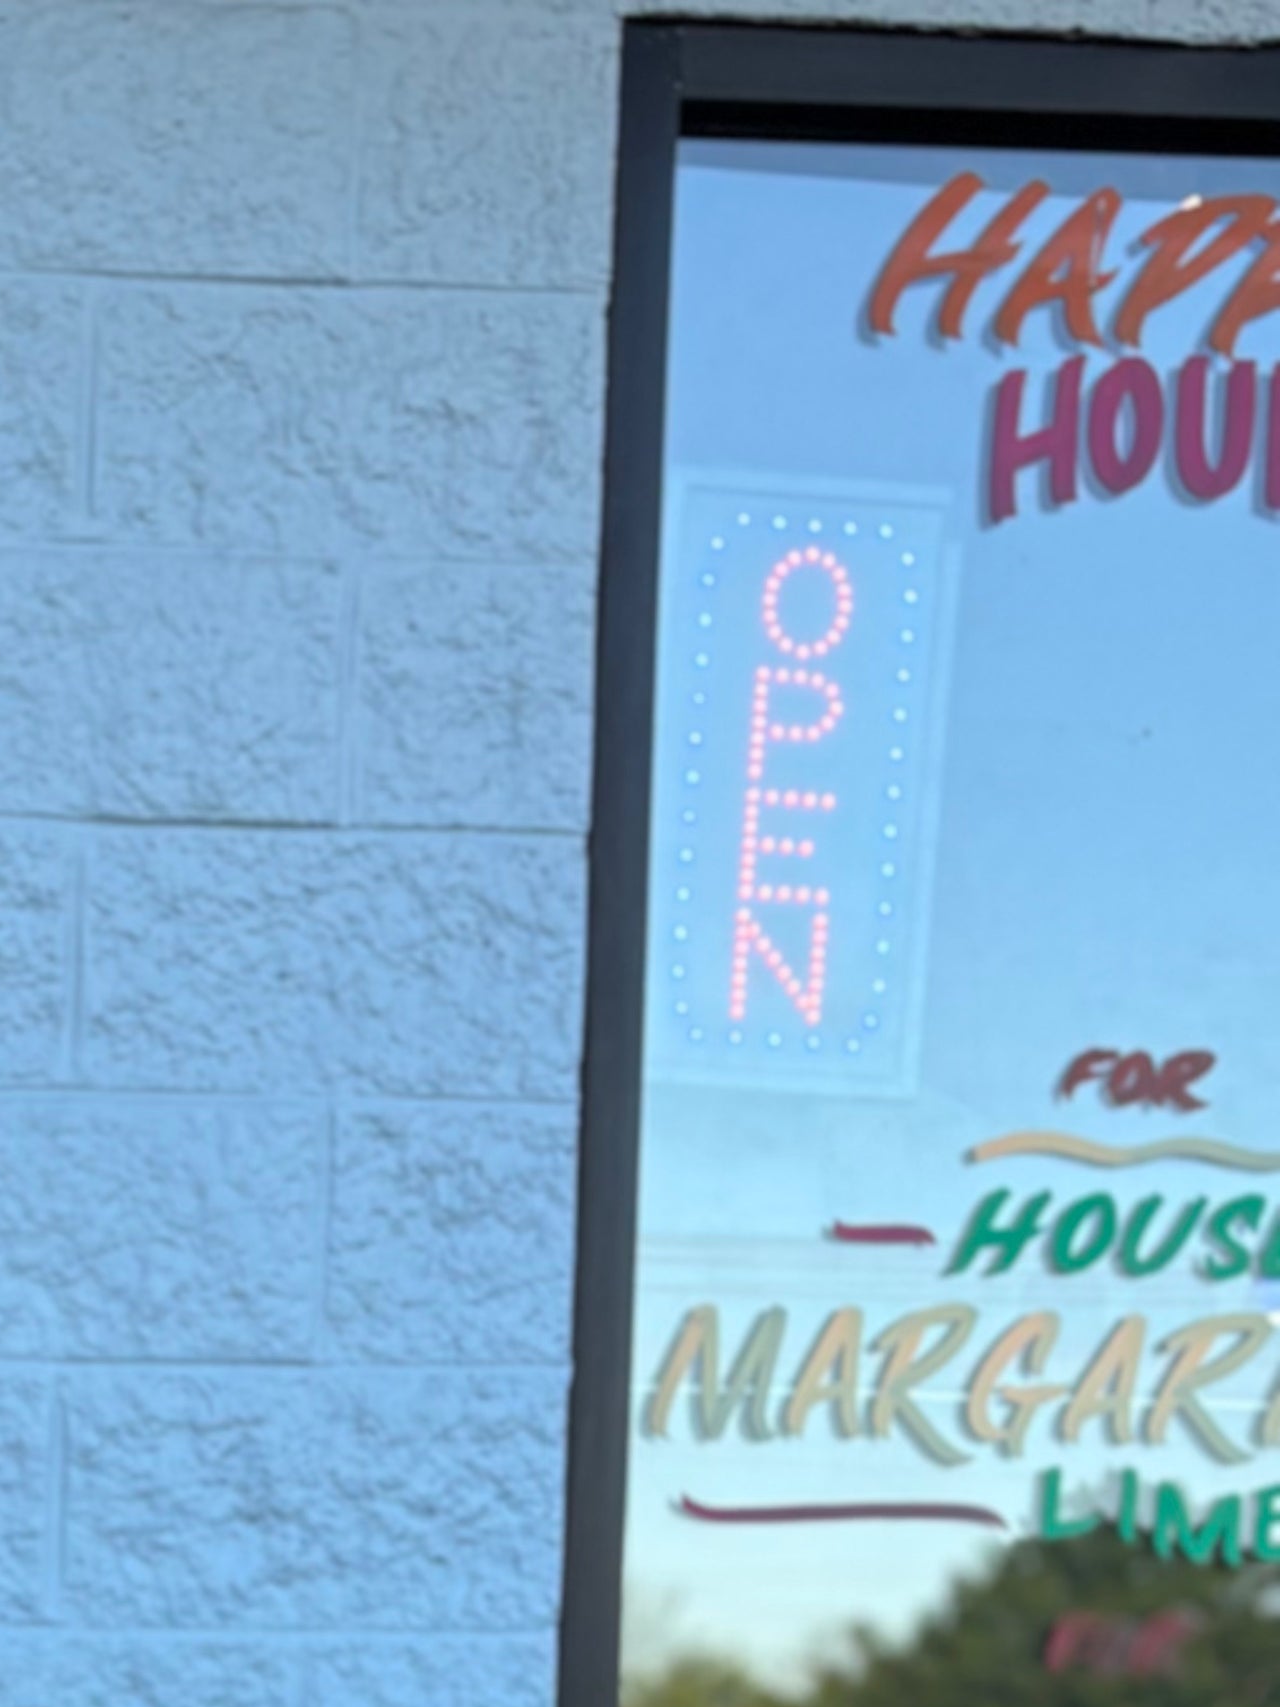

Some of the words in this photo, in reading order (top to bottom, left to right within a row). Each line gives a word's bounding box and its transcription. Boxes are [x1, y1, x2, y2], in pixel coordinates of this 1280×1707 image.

[992, 353, 1280, 523] HOU
[728, 546, 853, 1026] OPEN
[1058, 1048, 1216, 1111] FOR
